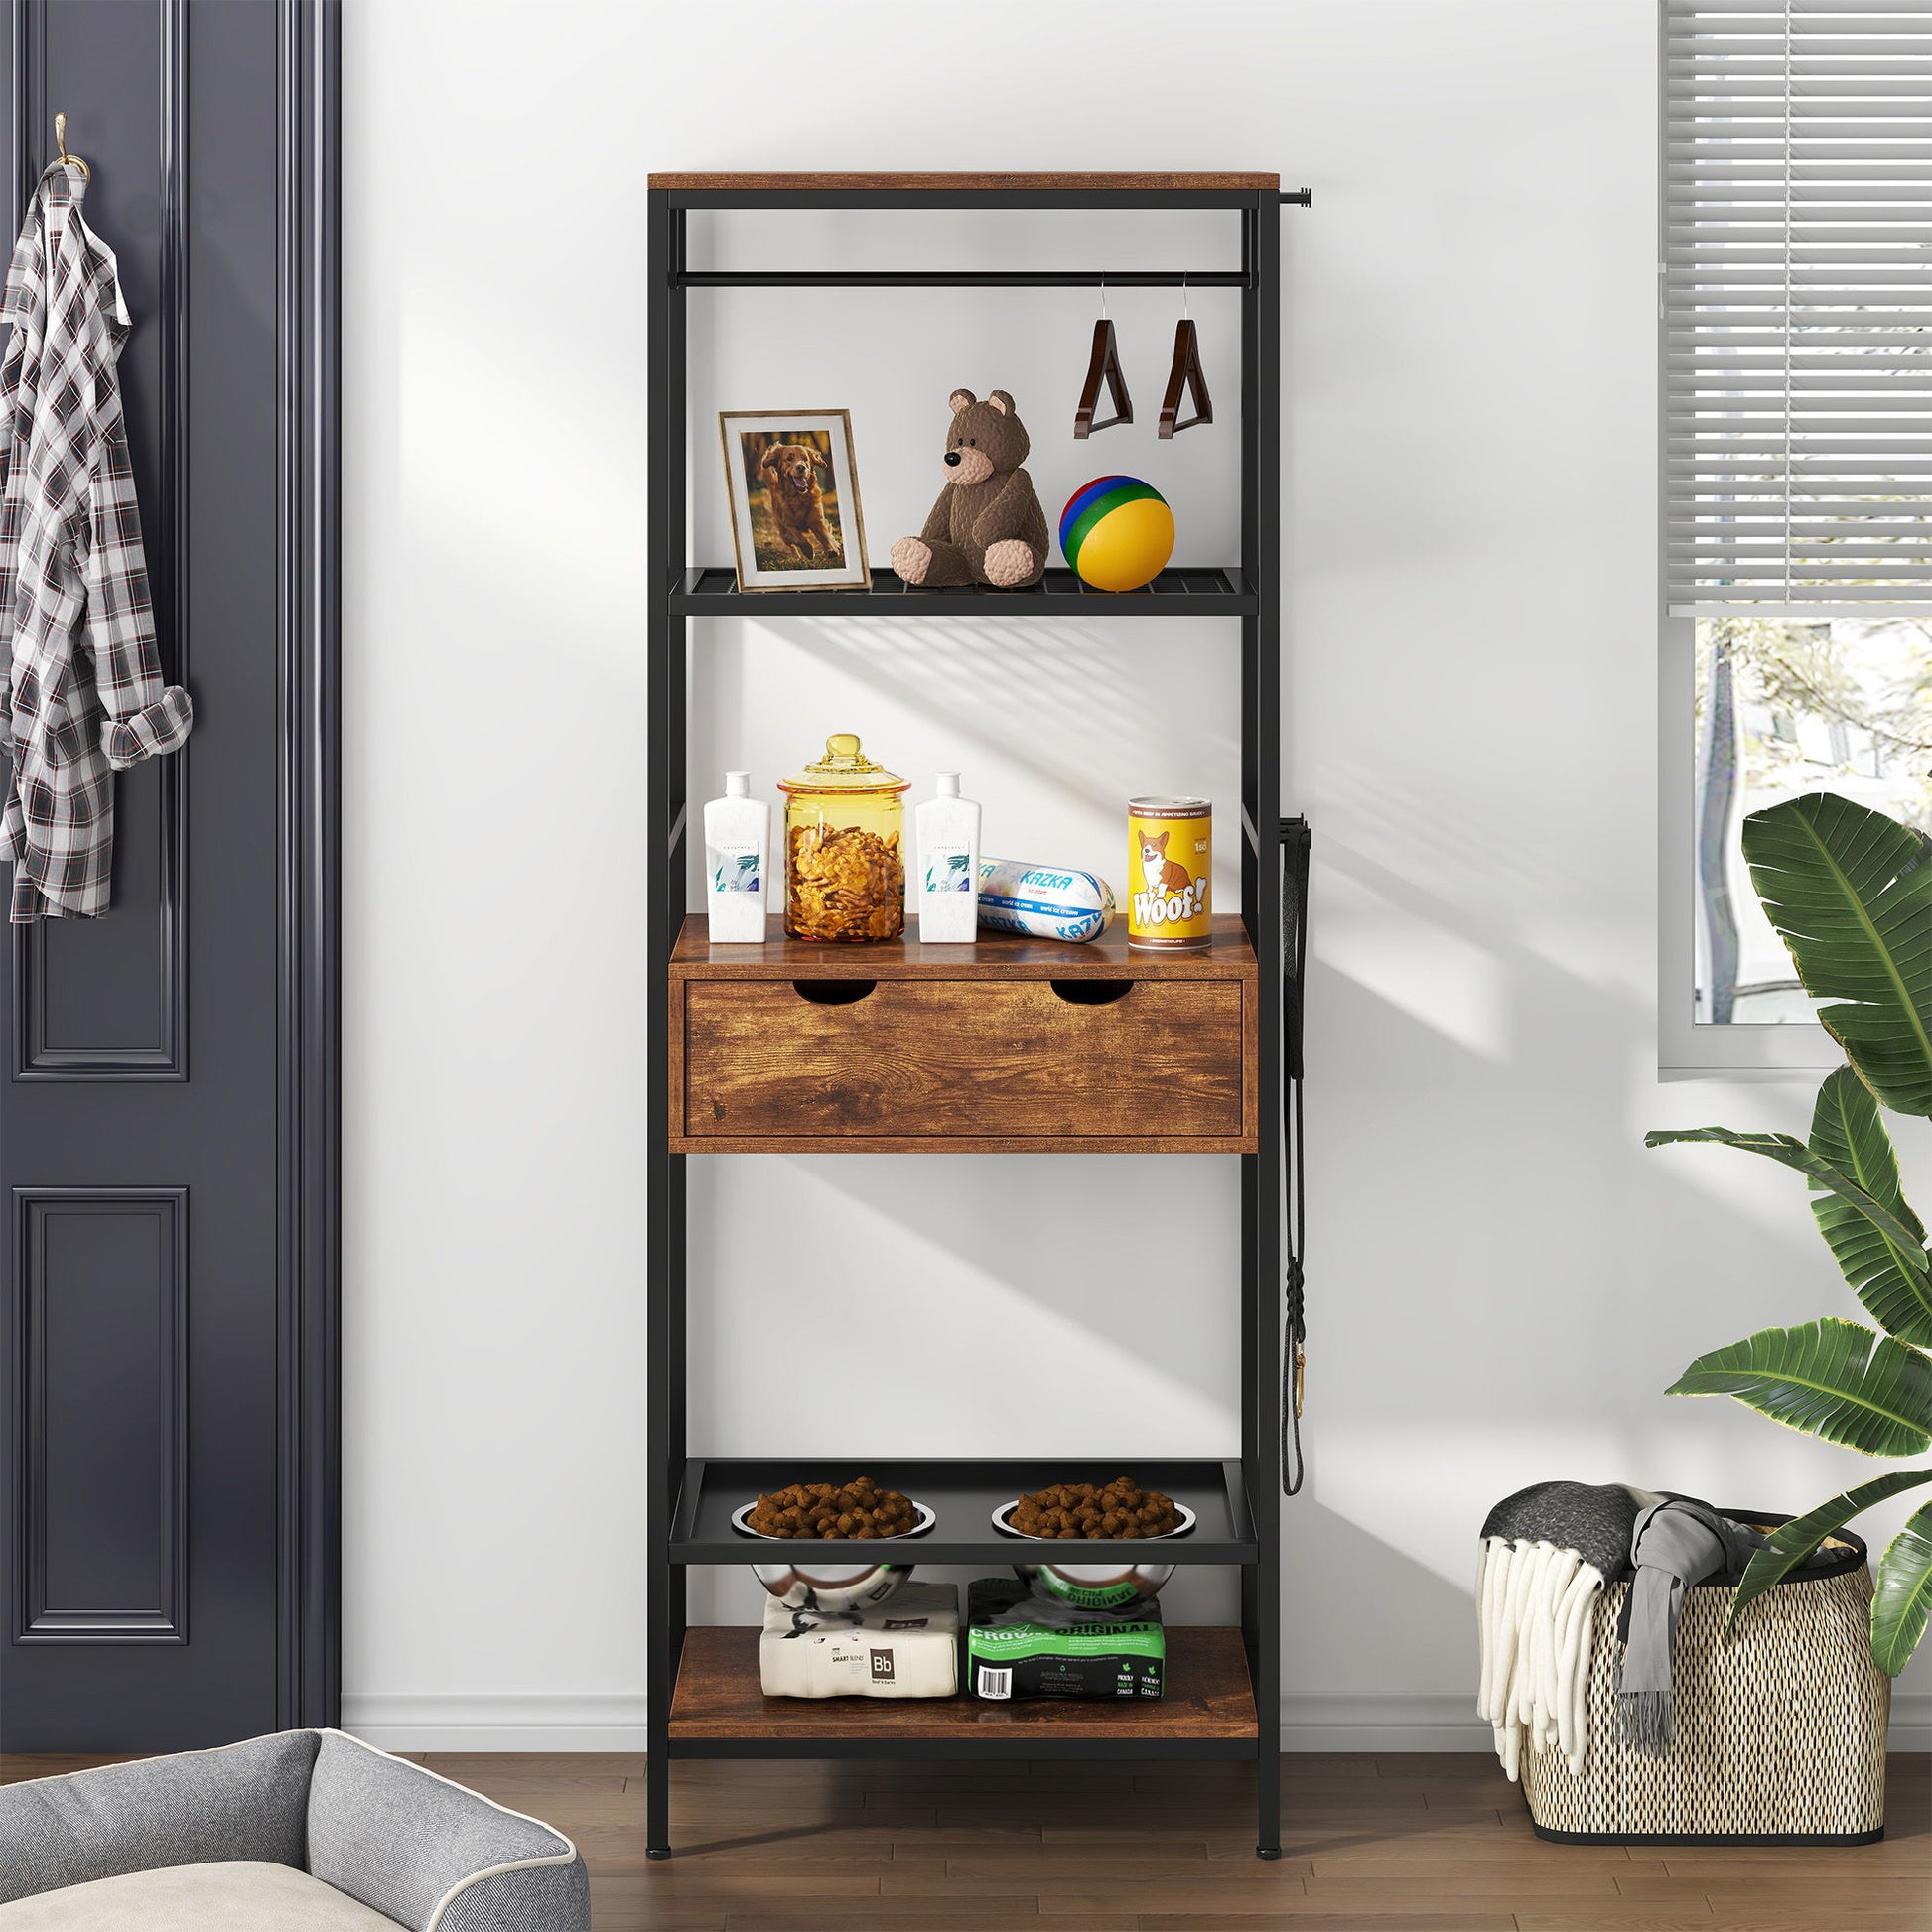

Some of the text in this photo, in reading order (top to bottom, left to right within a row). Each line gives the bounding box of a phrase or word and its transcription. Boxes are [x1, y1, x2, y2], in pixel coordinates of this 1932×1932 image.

[1020, 870, 1074, 890] KAZKA
[1133, 876, 1208, 928] Woof!
[1054, 1624, 1149, 1636] ORIGINAL
[874, 1656, 892, 1672] Bb
